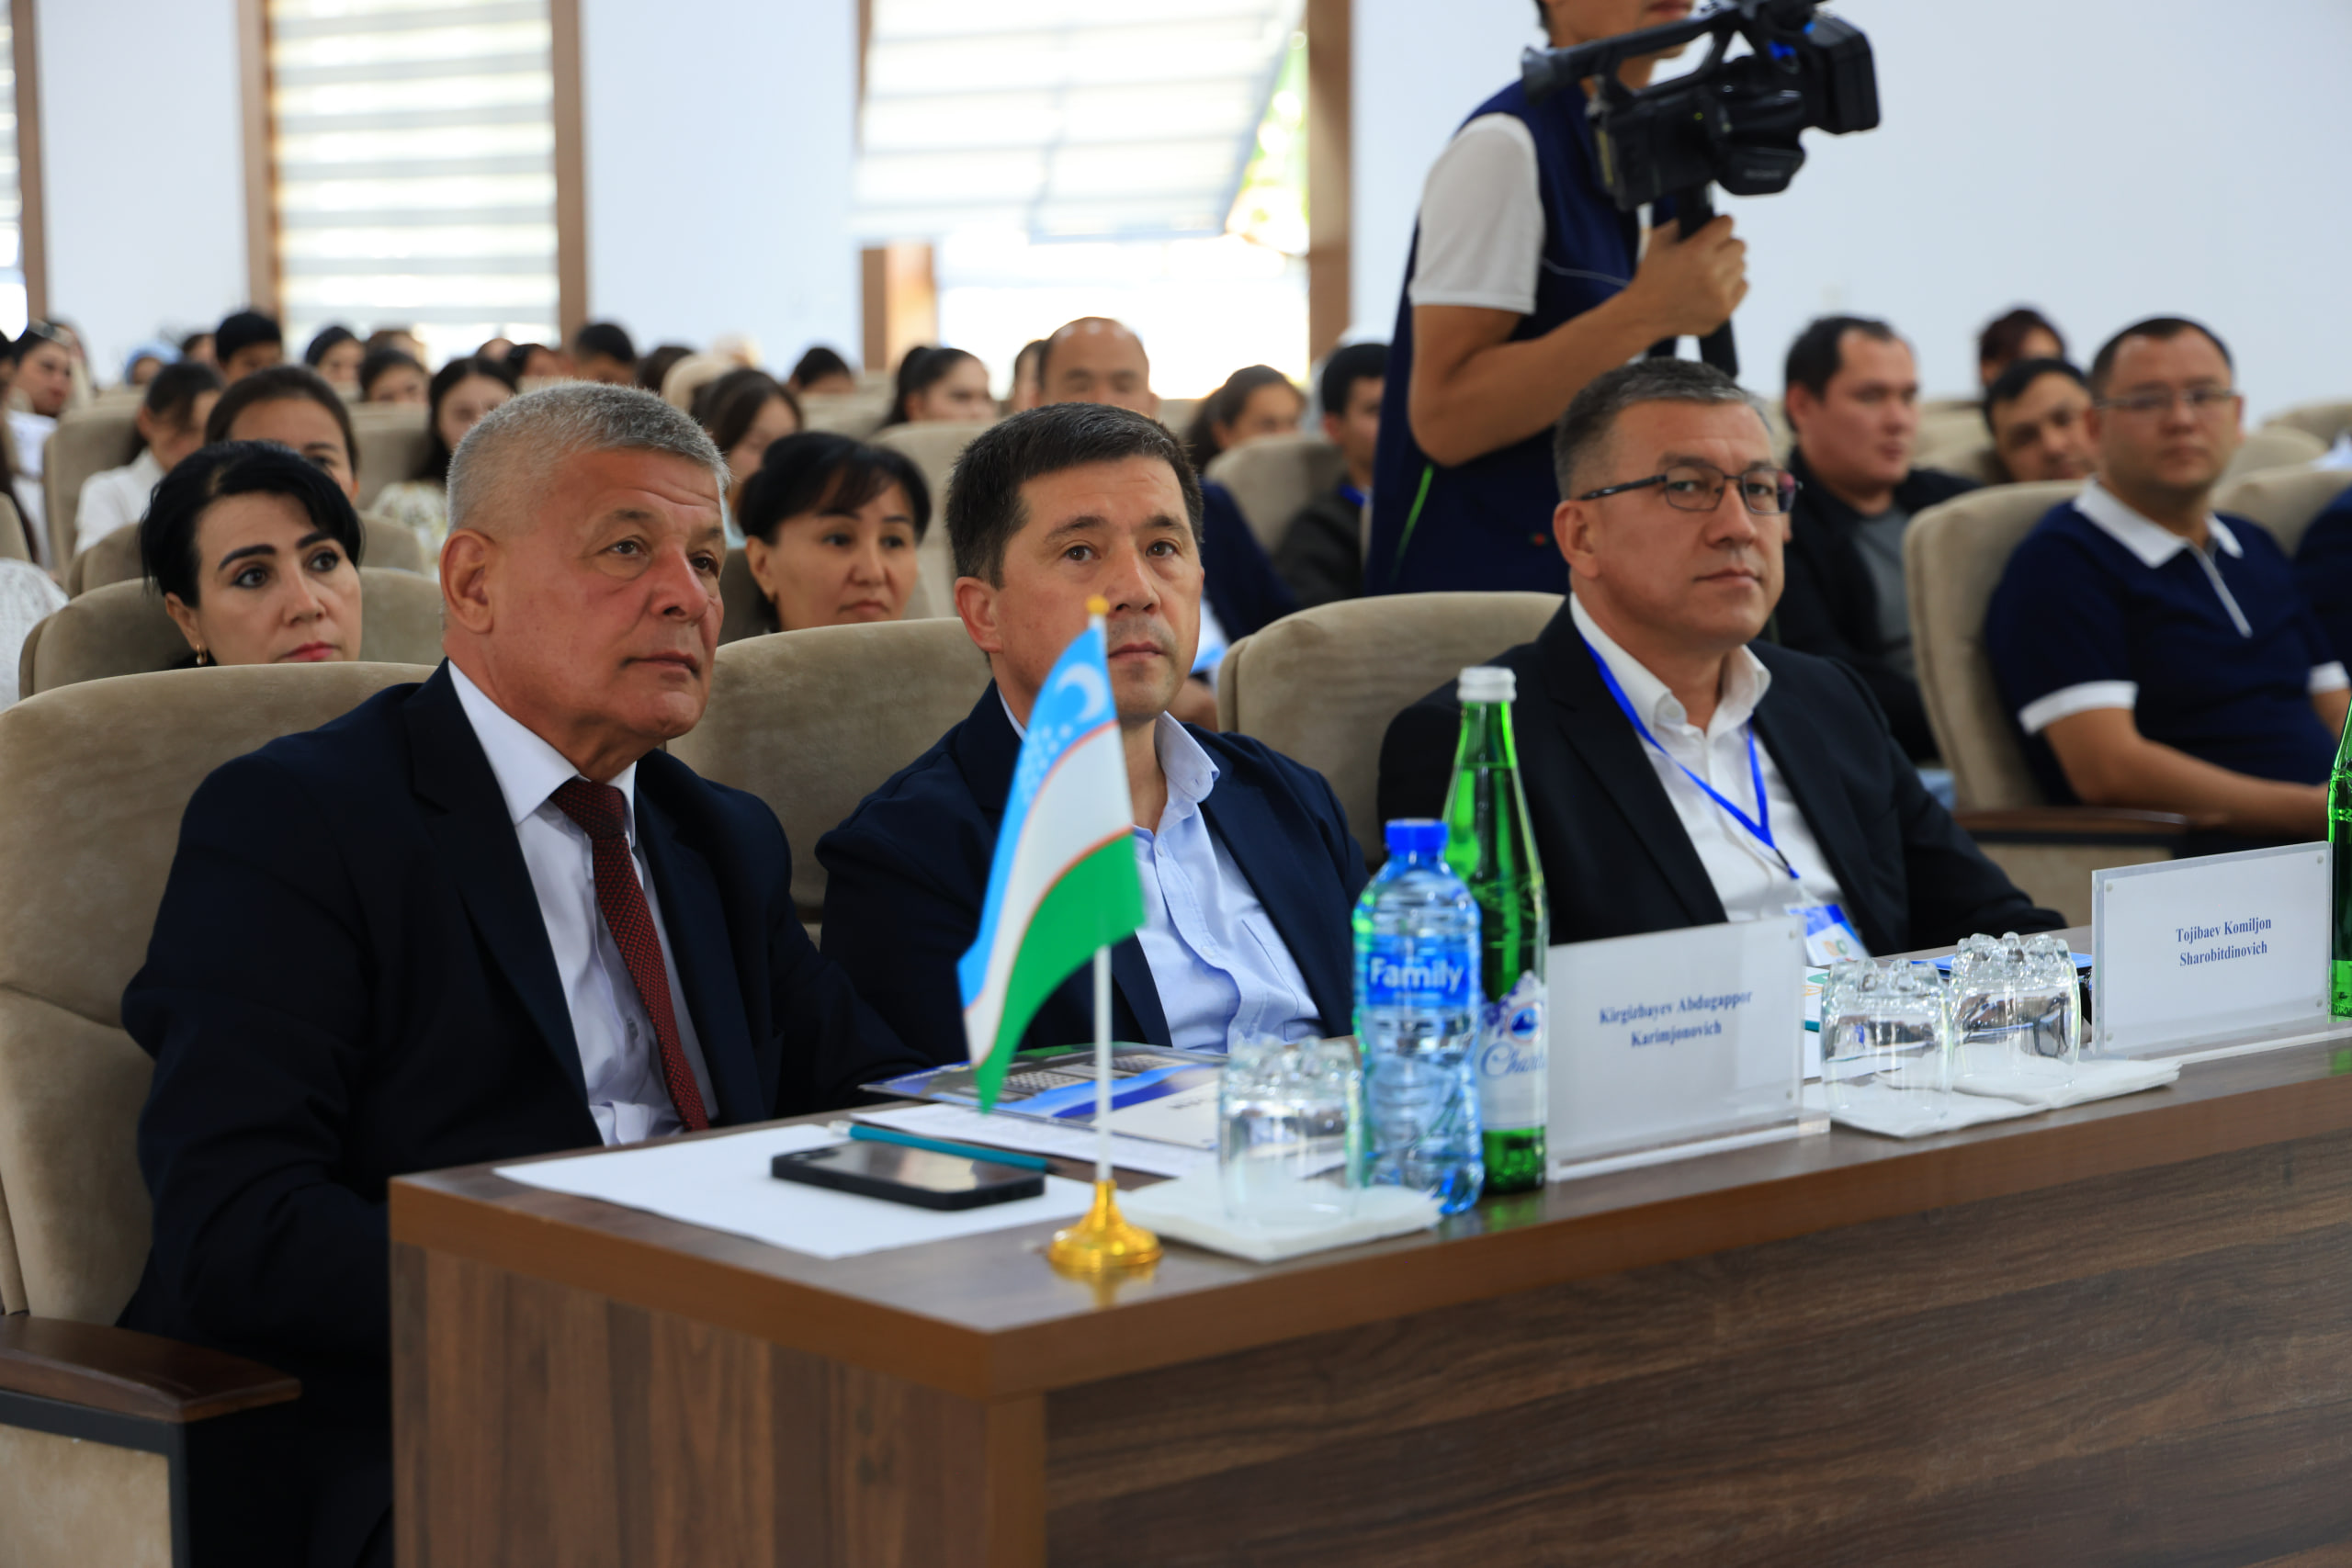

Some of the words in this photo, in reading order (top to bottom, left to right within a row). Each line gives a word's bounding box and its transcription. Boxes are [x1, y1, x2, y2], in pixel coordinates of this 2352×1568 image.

[2175, 925, 2221, 944] Tojibaev
[2223, 917, 2272, 935] Komiljon
[2179, 940, 2267, 966] Sharobitdinovich
[1370, 956, 1464, 995] Family
[1631, 1019, 1723, 1048] Karimjonovich
